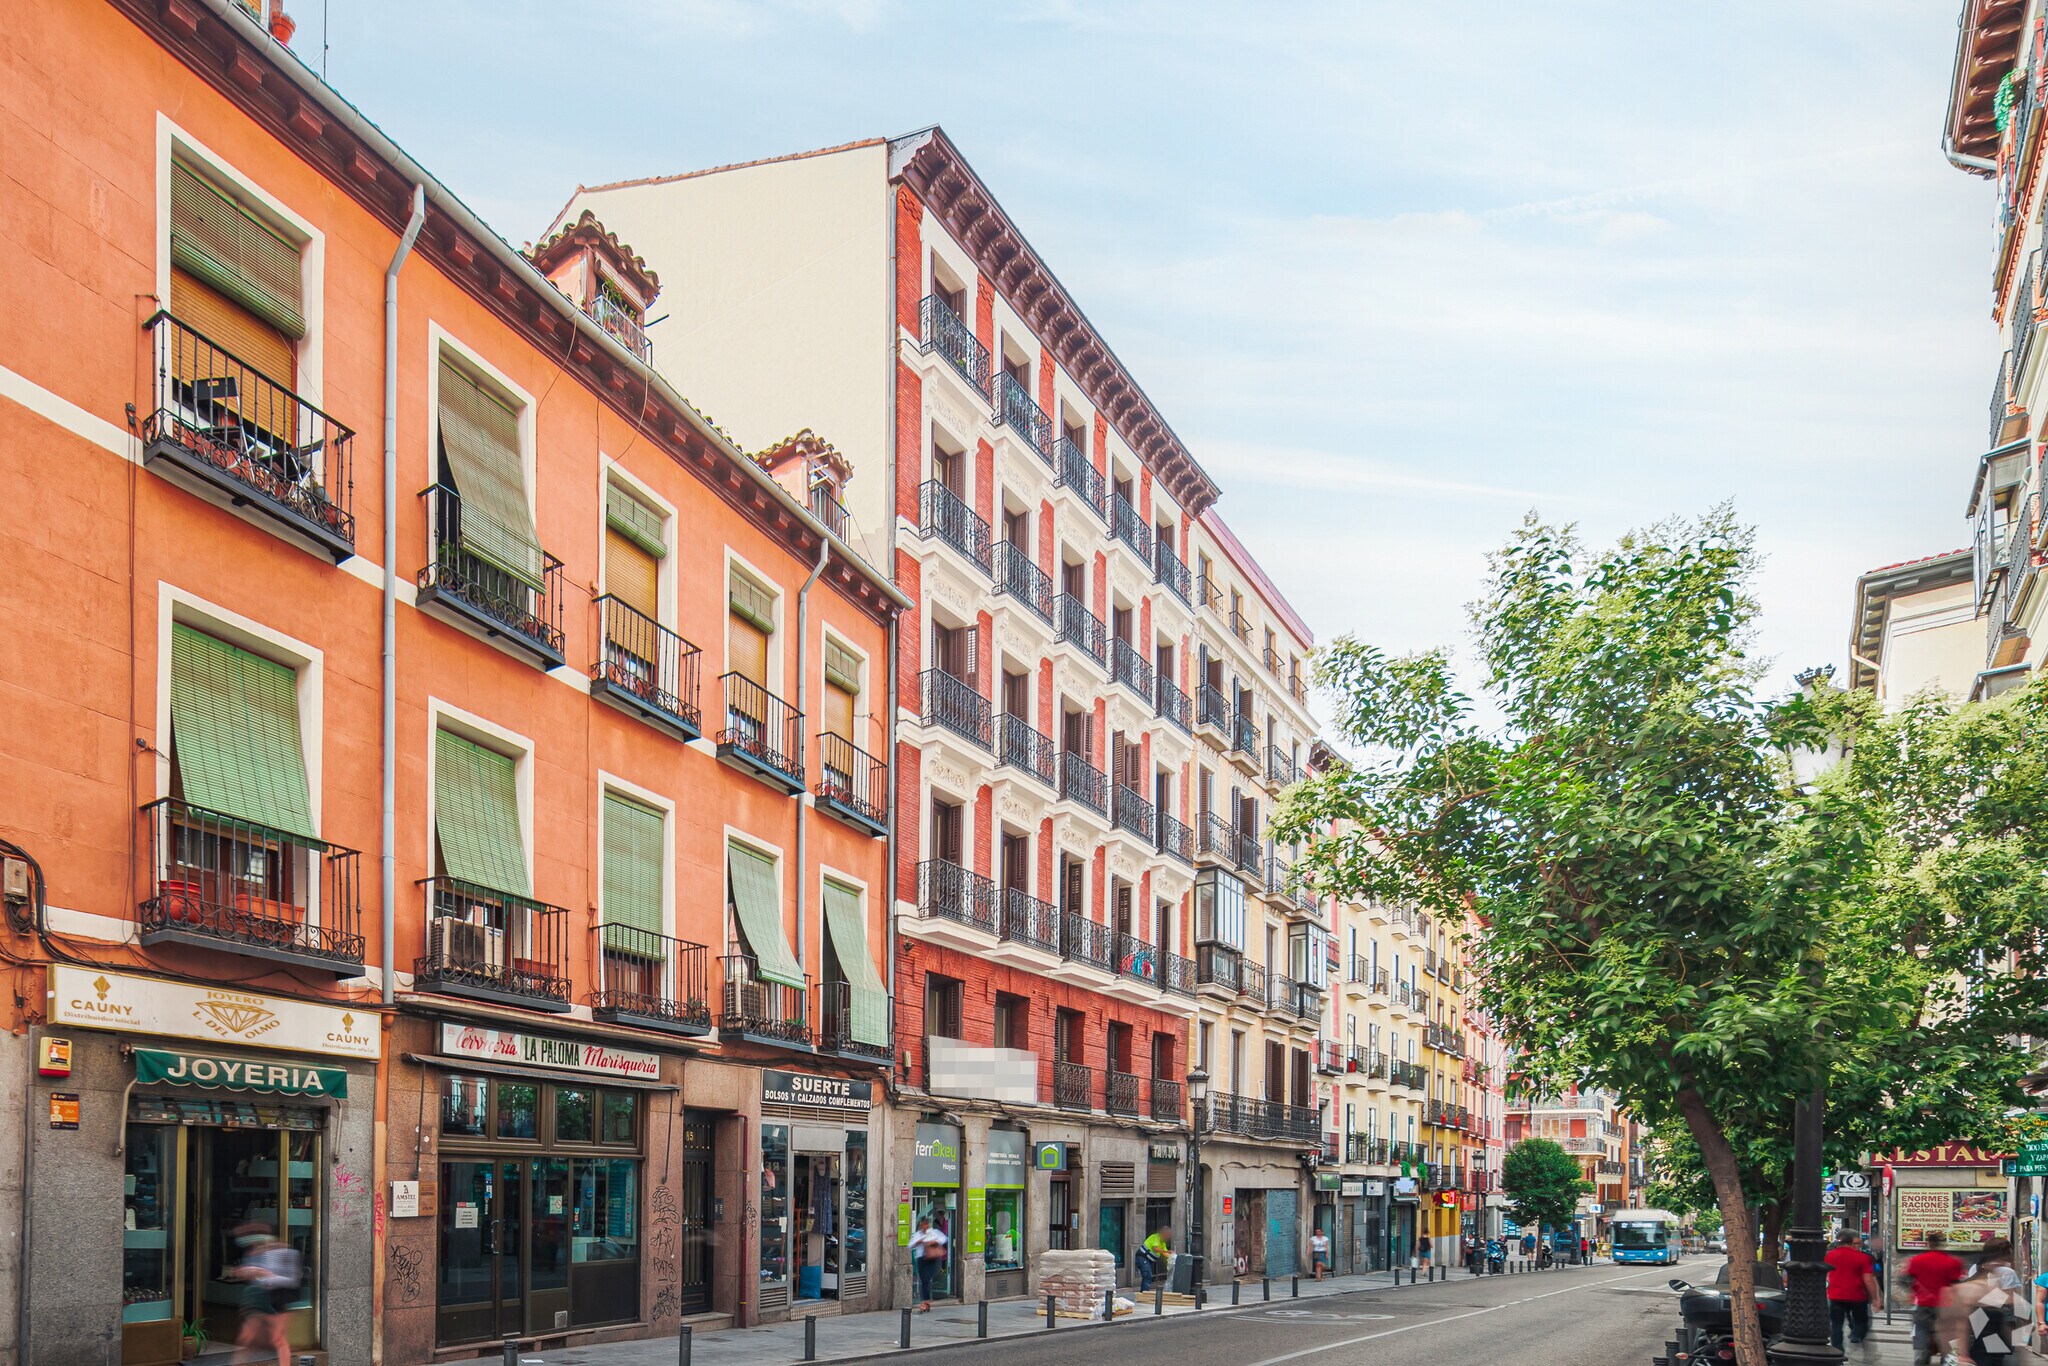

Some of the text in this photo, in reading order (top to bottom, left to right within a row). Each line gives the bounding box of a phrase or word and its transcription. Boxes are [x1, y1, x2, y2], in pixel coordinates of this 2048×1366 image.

[207, 991, 265, 1005] JOYERO
[71, 999, 133, 1015] CAUNY
[64, 1011, 140, 1025] Distribuidor oficial
[205, 1020, 229, 1037] DEL
[245, 1020, 280, 1039] OLMO
[327, 1033, 369, 1045] CAUNY
[524, 1036, 537, 1062] LA
[541, 1040, 580, 1066] PALOMA
[583, 1044, 657, 1076] Marisquería
[167, 1056, 324, 1090] JOYERIA
[792, 1076, 850, 1096] SUERTE
[765, 1089, 870, 1109] BOLSOS Y CALZADOS COMPLEMENTOS
[942, 1163, 956, 1172] Hoyos
